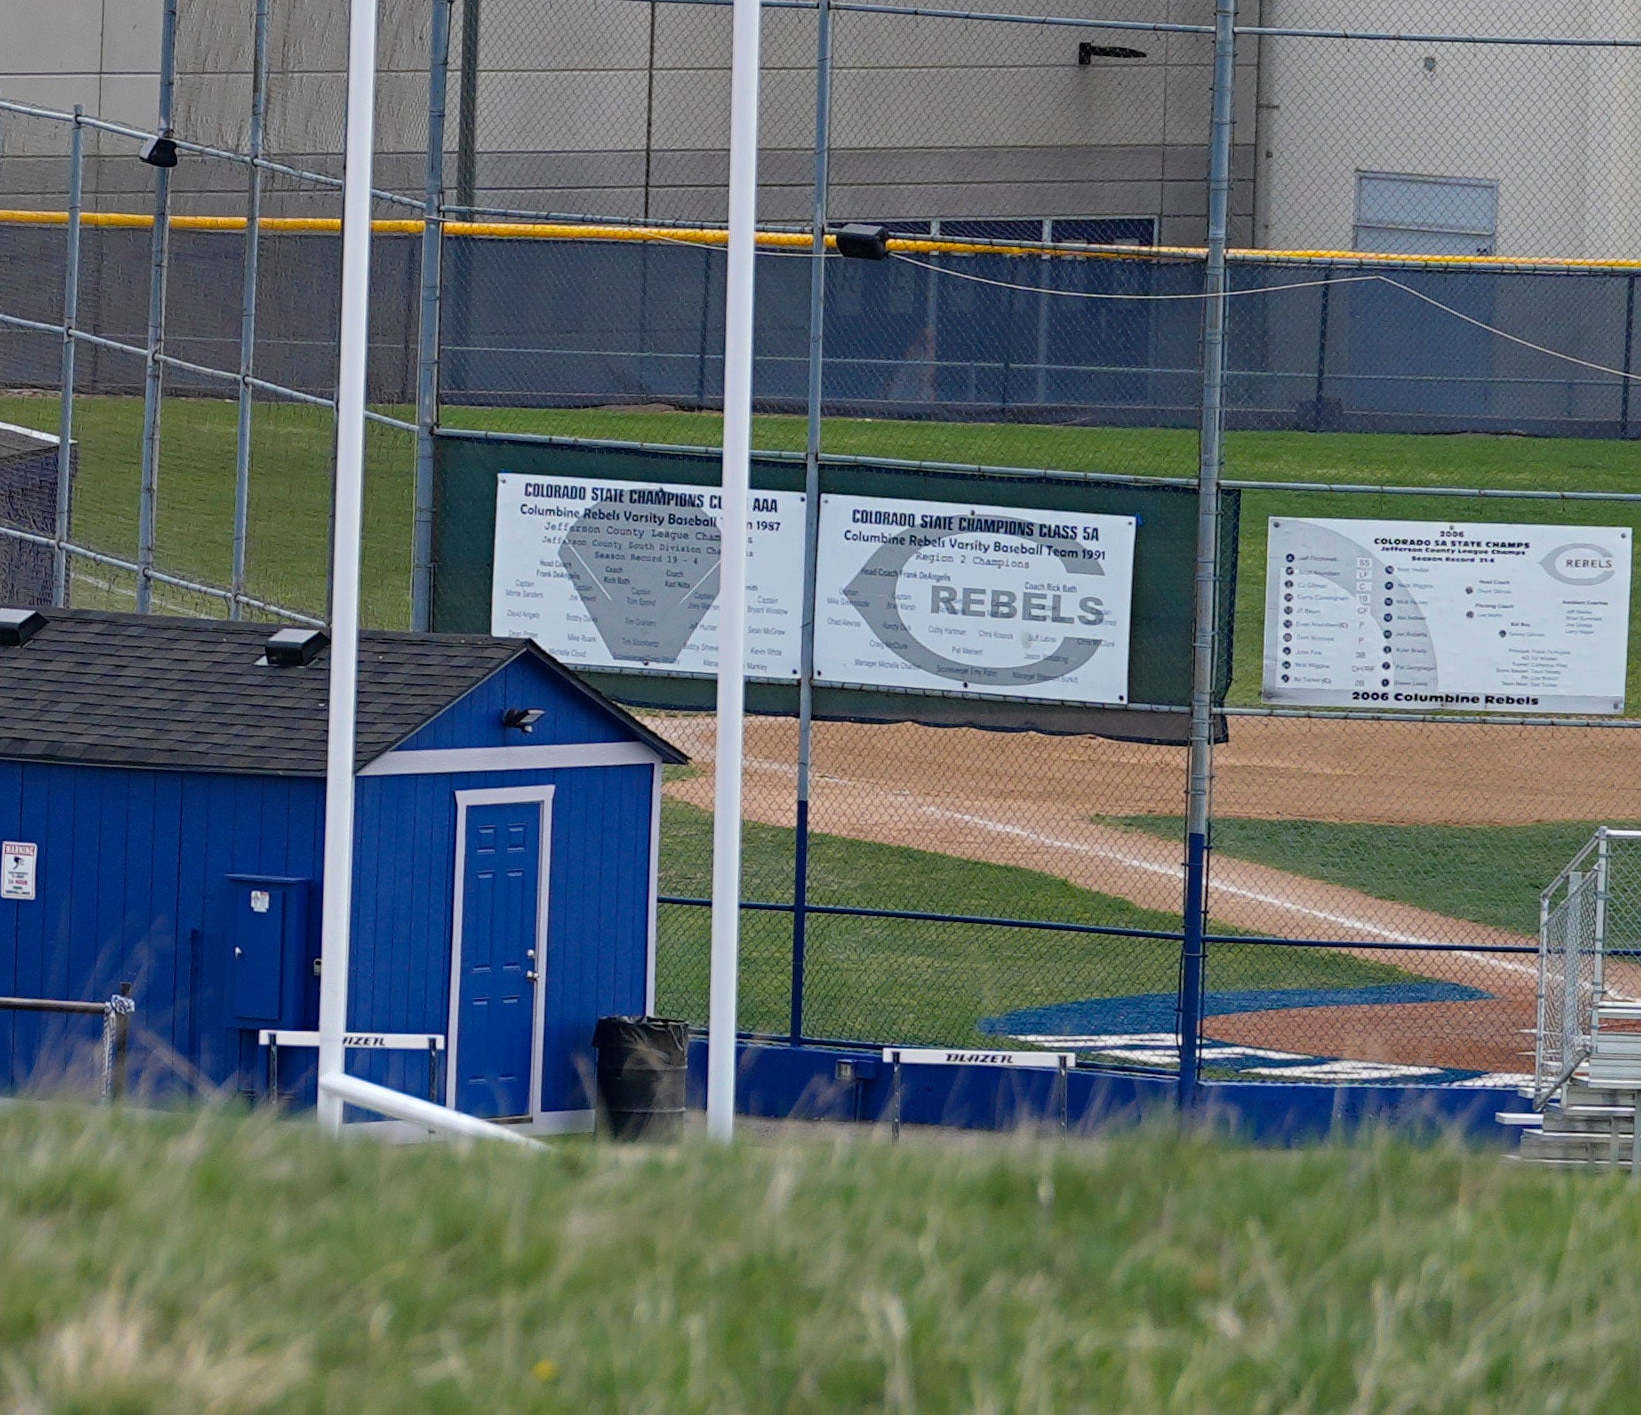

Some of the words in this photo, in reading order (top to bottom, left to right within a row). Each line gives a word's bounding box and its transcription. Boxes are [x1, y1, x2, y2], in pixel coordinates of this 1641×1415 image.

[524, 482, 586, 501] COLORADO
[591, 487, 625, 503] STATE
[629, 489, 705, 509] CHAMPIONS
[753, 497, 778, 513] AAA
[520, 503, 580, 519] Columbine
[583, 508, 620, 521] Rebels
[623, 510, 664, 526] Varsity
[668, 513, 717, 528] Baseball
[544, 522, 601, 534] Jefferson
[606, 526, 645, 540] County
[651, 529, 689, 542] League
[757, 521, 781, 532] 1987
[852, 509, 915, 528] COLORADO
[921, 515, 954, 531] STATE
[958, 517, 1034, 537] CHAMPIONS
[1038, 523, 1077, 541] CLASS
[1083, 526, 1099, 542] 5A
[592, 539, 622, 551] County
[628, 542, 655, 551] South
[660, 544, 702, 555] Division
[844, 529, 905, 546] Columbine
[909, 534, 945, 548] Rebels
[949, 538, 990, 554] Varsity
[994, 540, 1043, 556] Baseball
[1046, 545, 1079, 559] Team
[1082, 548, 1106, 561] 1991
[1374, 538, 1431, 546] COLORADO
[1486, 541, 1531, 550] CHAMPS
[1425, 547, 1455, 555] County
[1458, 548, 1489, 556] League
[1491, 549, 1526, 557] Champs
[915, 551, 954, 564] Region
[960, 553, 966, 564] 2
[972, 556, 1030, 569] Champions
[1566, 559, 1612, 568] REBELS
[930, 585, 1104, 626] REBELS
[1352, 691, 1389, 701] 2006
[1394, 692, 1480, 704] Columbine
[1484, 695, 1539, 706] Rebels
[946, 1052, 1014, 1064] BLAZER
